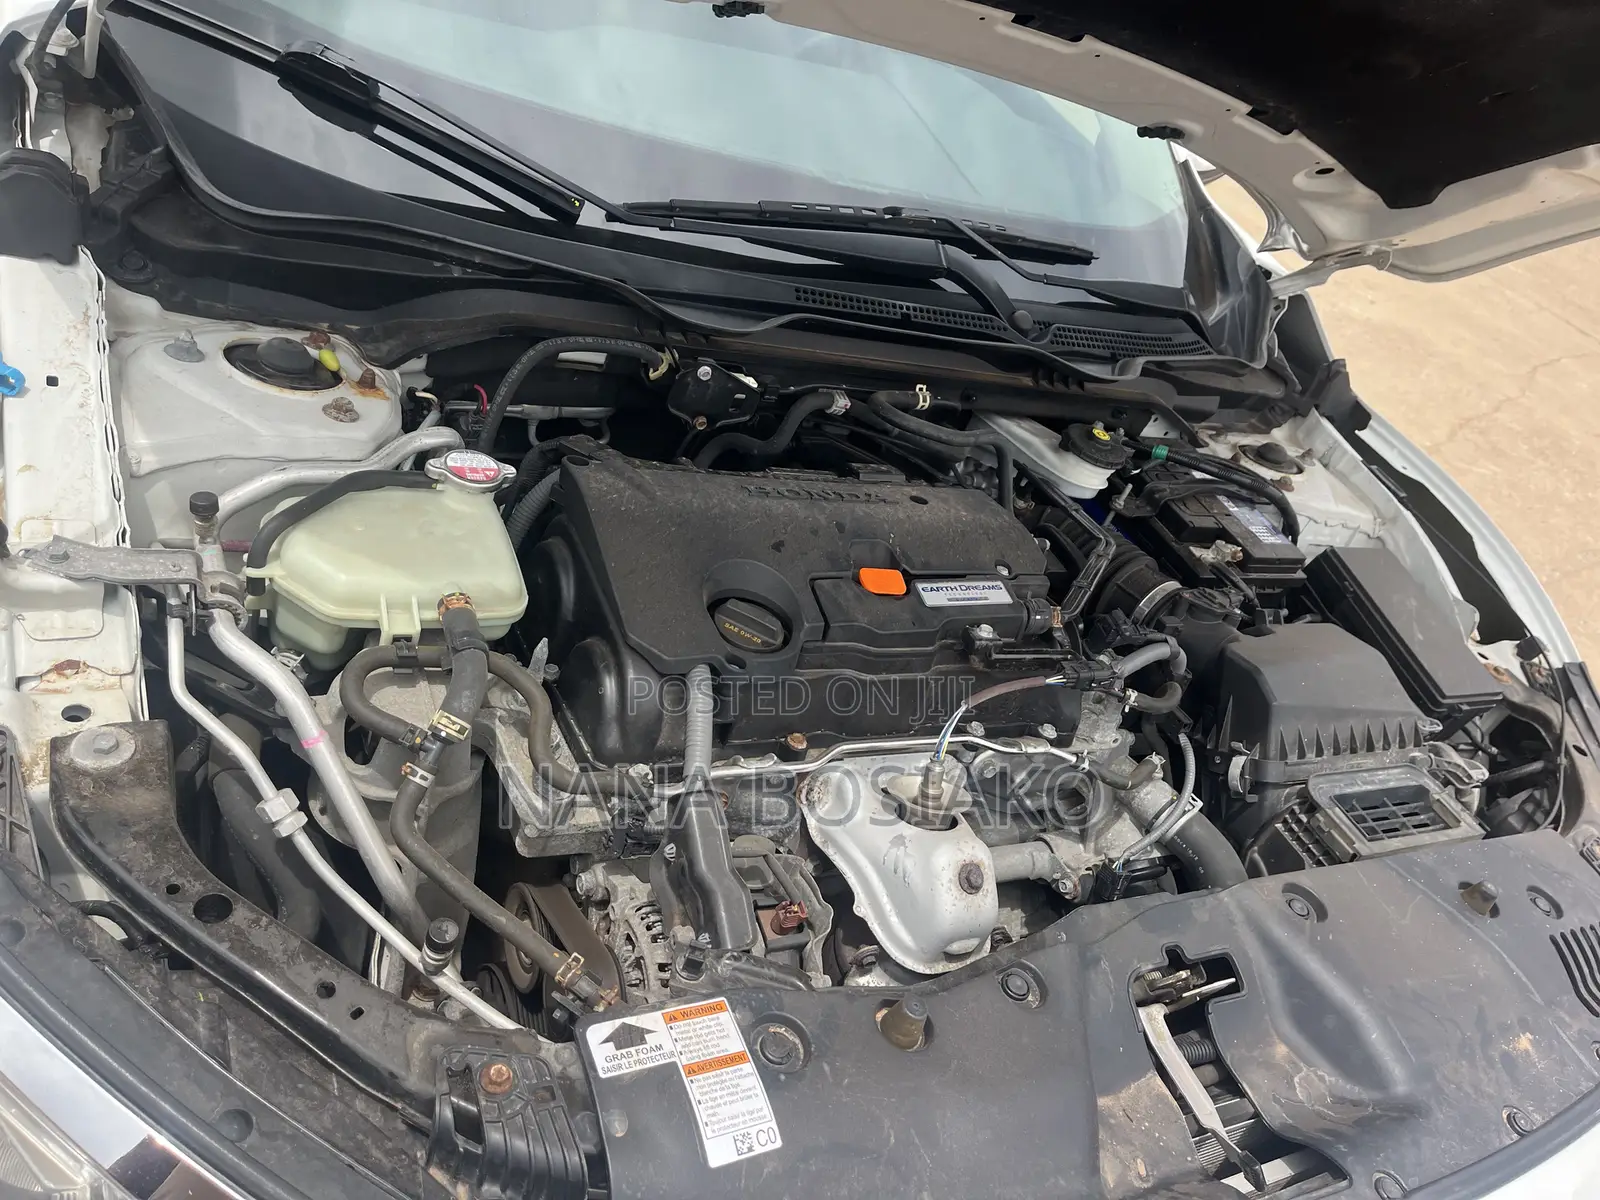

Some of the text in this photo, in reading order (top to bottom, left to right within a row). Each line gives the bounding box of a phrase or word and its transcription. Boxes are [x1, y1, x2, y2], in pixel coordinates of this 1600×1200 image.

[921, 584, 1003, 593] EARTH DREAMS
[724, 622, 740, 633] SAE
[680, 1003, 723, 1018] WARNING
[604, 1043, 664, 1063] GRAB FOAM
[601, 1050, 677, 1075] SAISIR LE PROTECTEUR
[696, 1053, 747, 1073] AVERTISSEMENT
